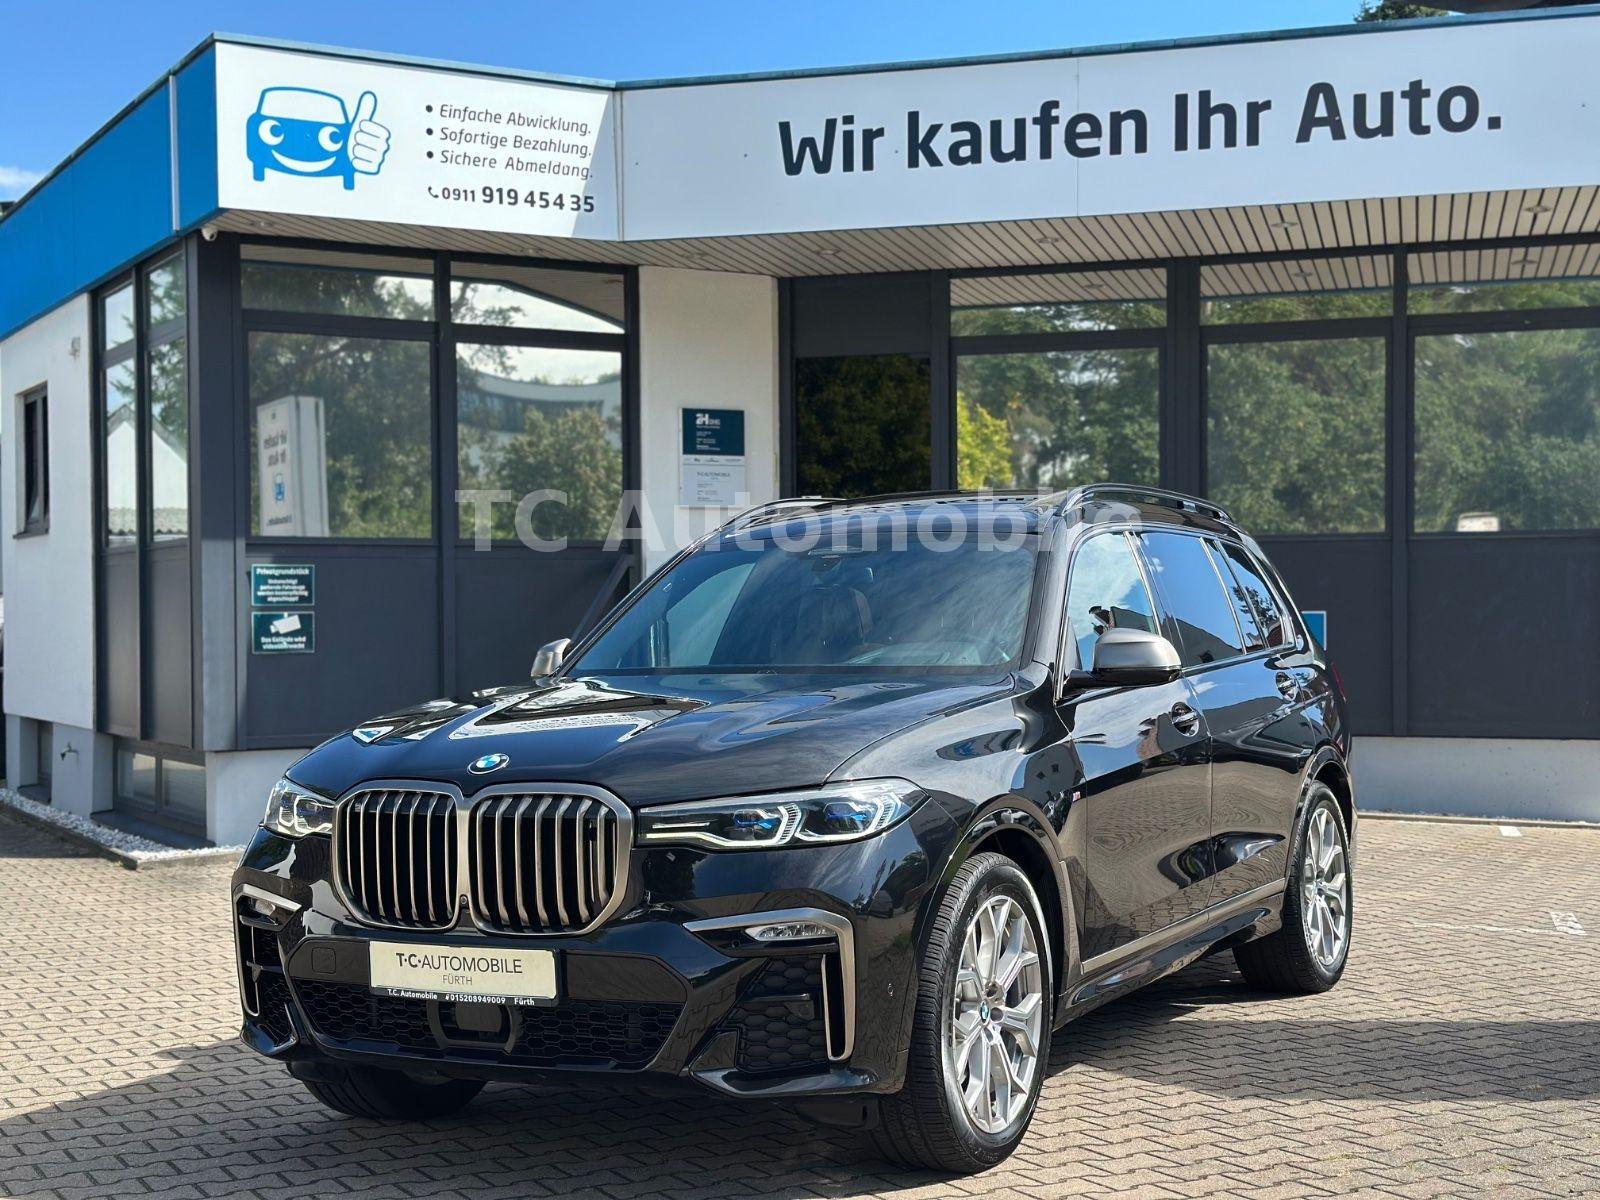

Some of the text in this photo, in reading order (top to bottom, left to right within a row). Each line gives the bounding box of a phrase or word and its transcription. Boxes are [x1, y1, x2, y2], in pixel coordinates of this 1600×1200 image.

[440, 104, 592, 137] Einfache Abwicklung.
[778, 79, 1501, 176] Wir kaufen Ihr Auto.
[440, 127, 592, 159] Sofortige Bezahlung.
[440, 150, 594, 181] Sichere Abmeldung.
[442, 187, 476, 203] 0911
[482, 186, 519, 206] 919
[442, 974, 473, 986] FÜRTH
[387, 988, 399, 996] T.C.
[400, 990, 438, 1000] Automobile
[514, 997, 535, 1006] Fürth
